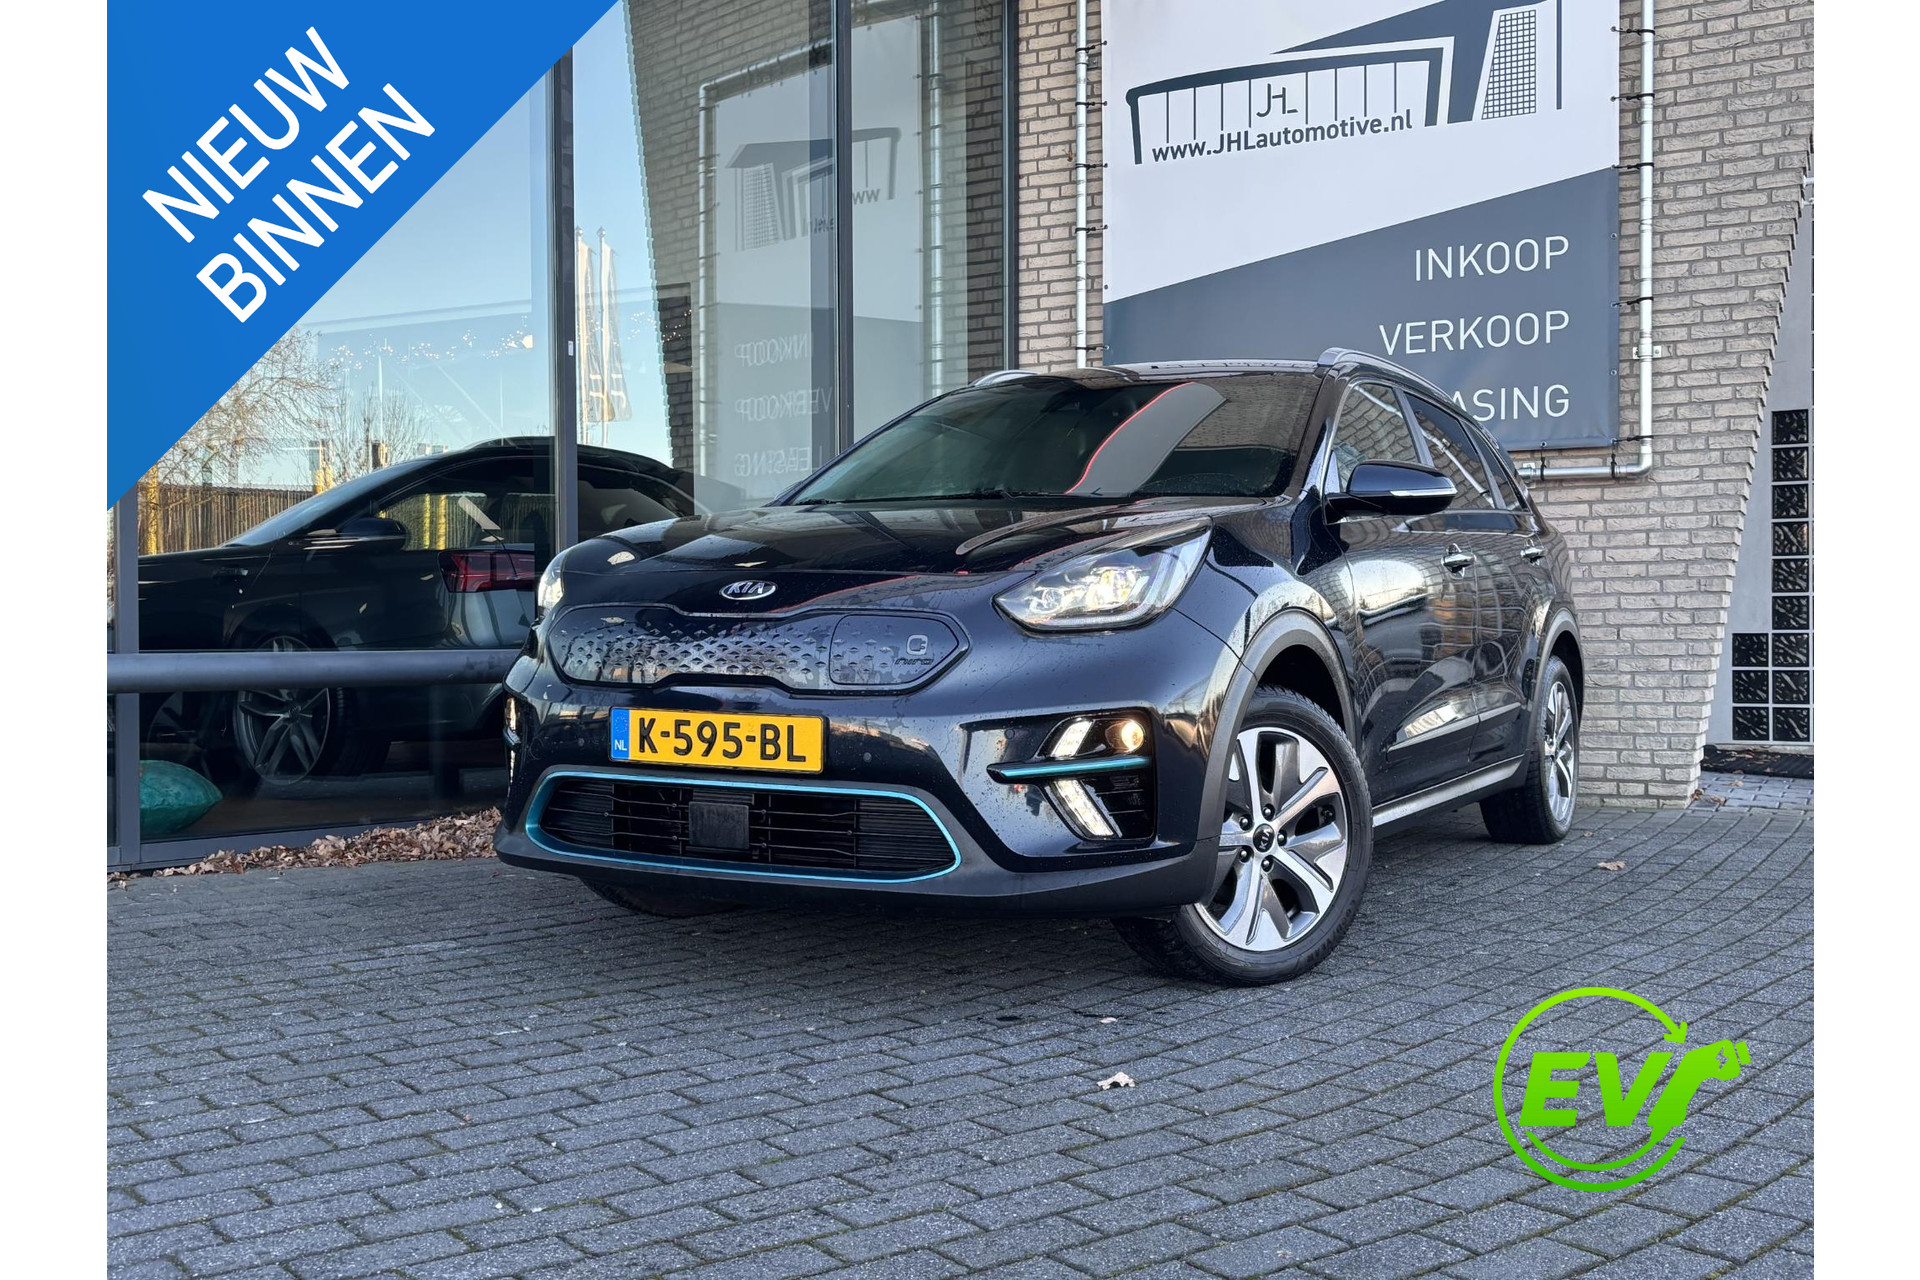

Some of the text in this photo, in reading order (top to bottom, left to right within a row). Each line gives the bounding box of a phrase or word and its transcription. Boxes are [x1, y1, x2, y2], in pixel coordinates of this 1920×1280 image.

[1256, 83, 1298, 117] JHL
[1152, 109, 1412, 162] www.JHLautomotive.nl
[1415, 236, 1569, 281] INKOOP
[1379, 310, 1570, 356] VERKOOP
[727, 581, 765, 595] KIA
[614, 739, 628, 751] NL
[638, 717, 807, 762] K-595-BL
[1259, 828, 1273, 850] KIA
